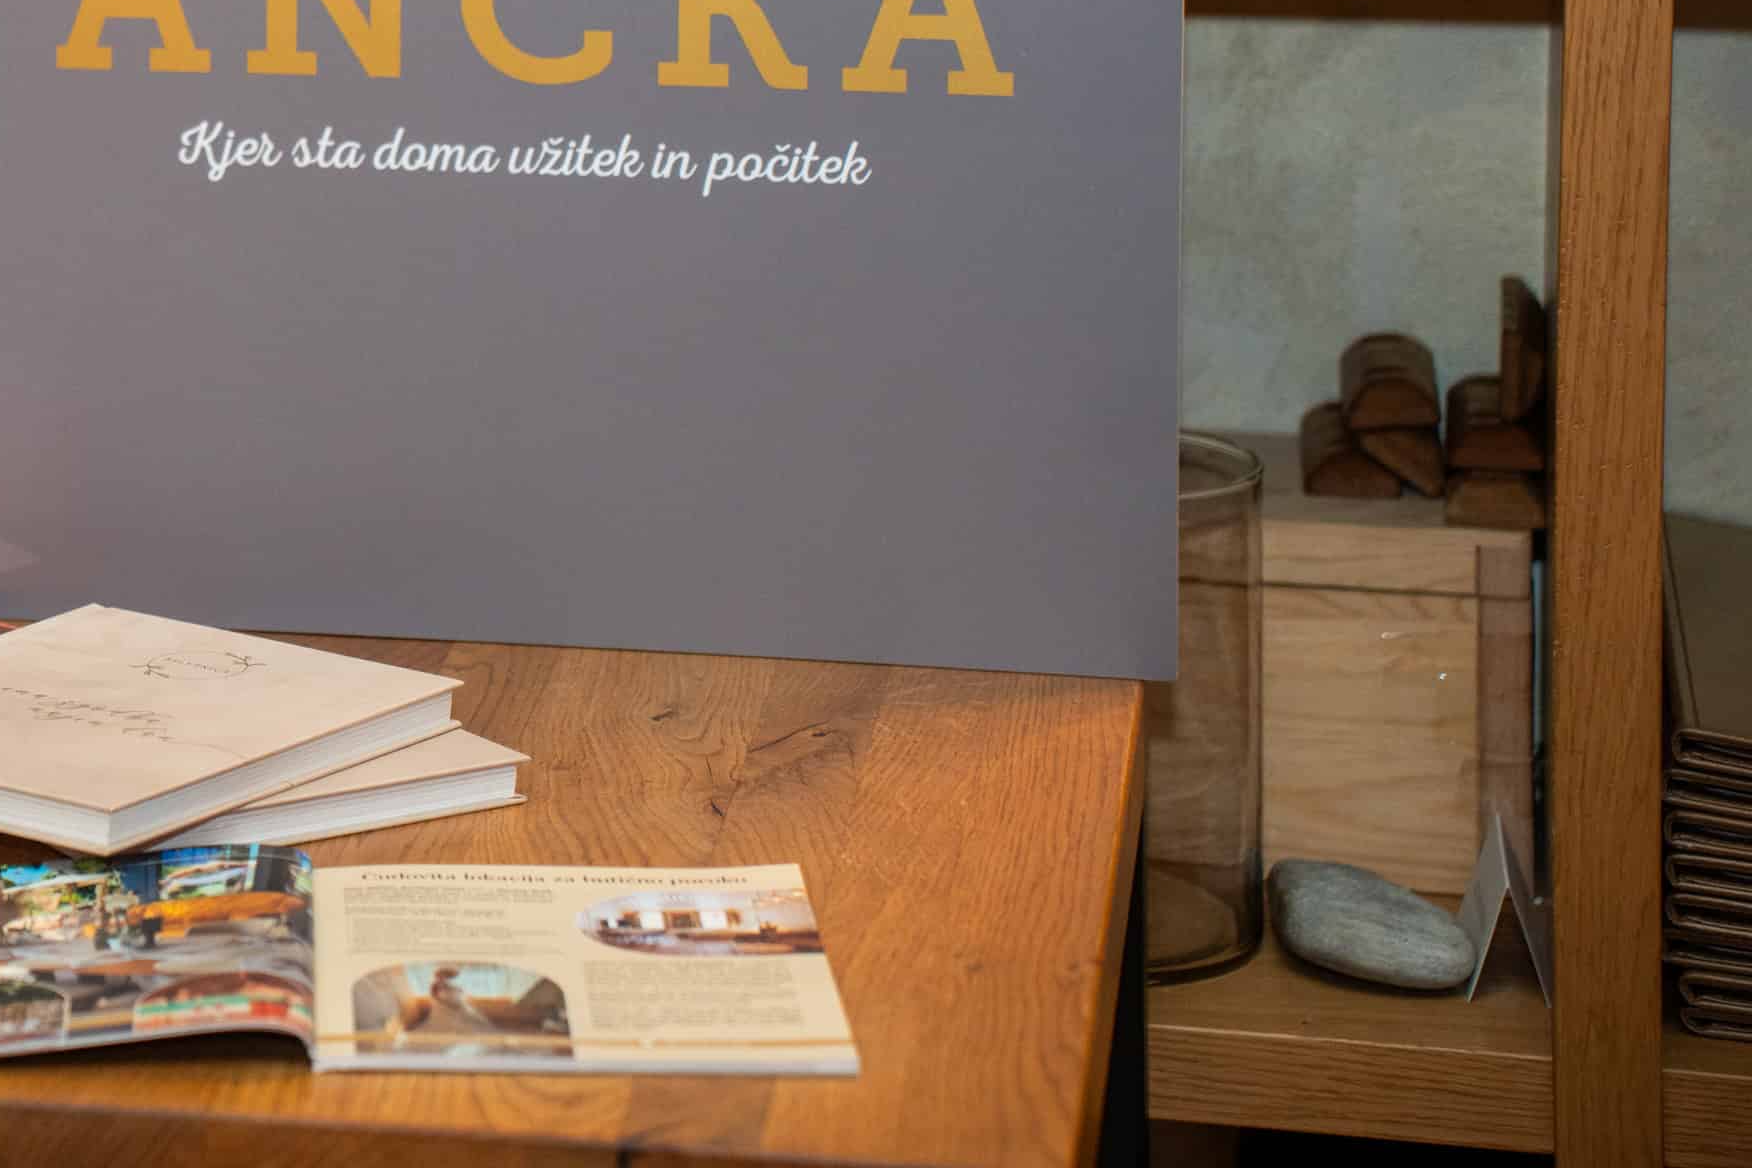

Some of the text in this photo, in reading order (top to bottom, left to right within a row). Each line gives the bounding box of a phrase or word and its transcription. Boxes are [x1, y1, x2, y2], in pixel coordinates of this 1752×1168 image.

[178, 119, 874, 198] Kjer sta doma užitek in počitek
